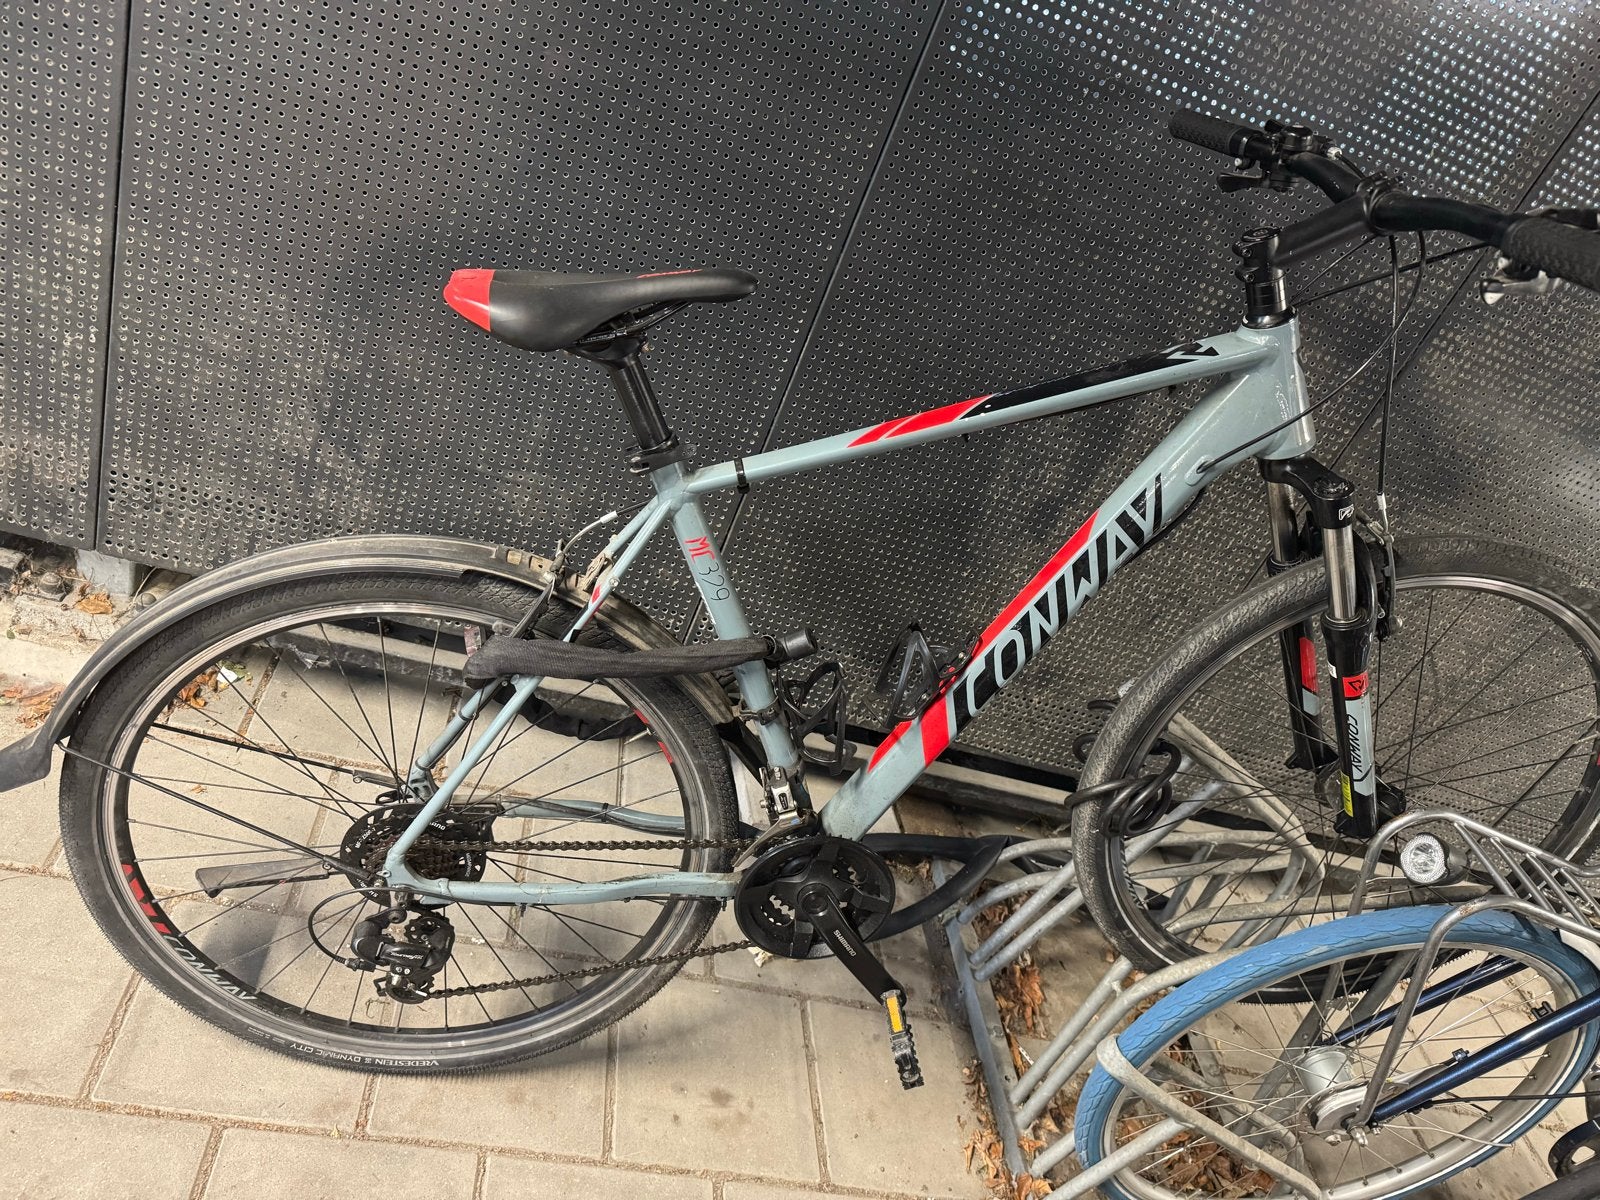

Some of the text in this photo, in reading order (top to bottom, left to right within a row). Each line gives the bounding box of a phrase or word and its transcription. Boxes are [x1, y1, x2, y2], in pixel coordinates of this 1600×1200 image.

[699, 562, 730, 600] 329
[964, 473, 1158, 718] CONWAY
[1347, 713, 1363, 773] CONWAY
[162, 935, 258, 1000] CONWAY
[833, 929, 857, 957] SHIMANO
[290, 1042, 439, 1067] VREDESTEIN DYNAMIC CITY
